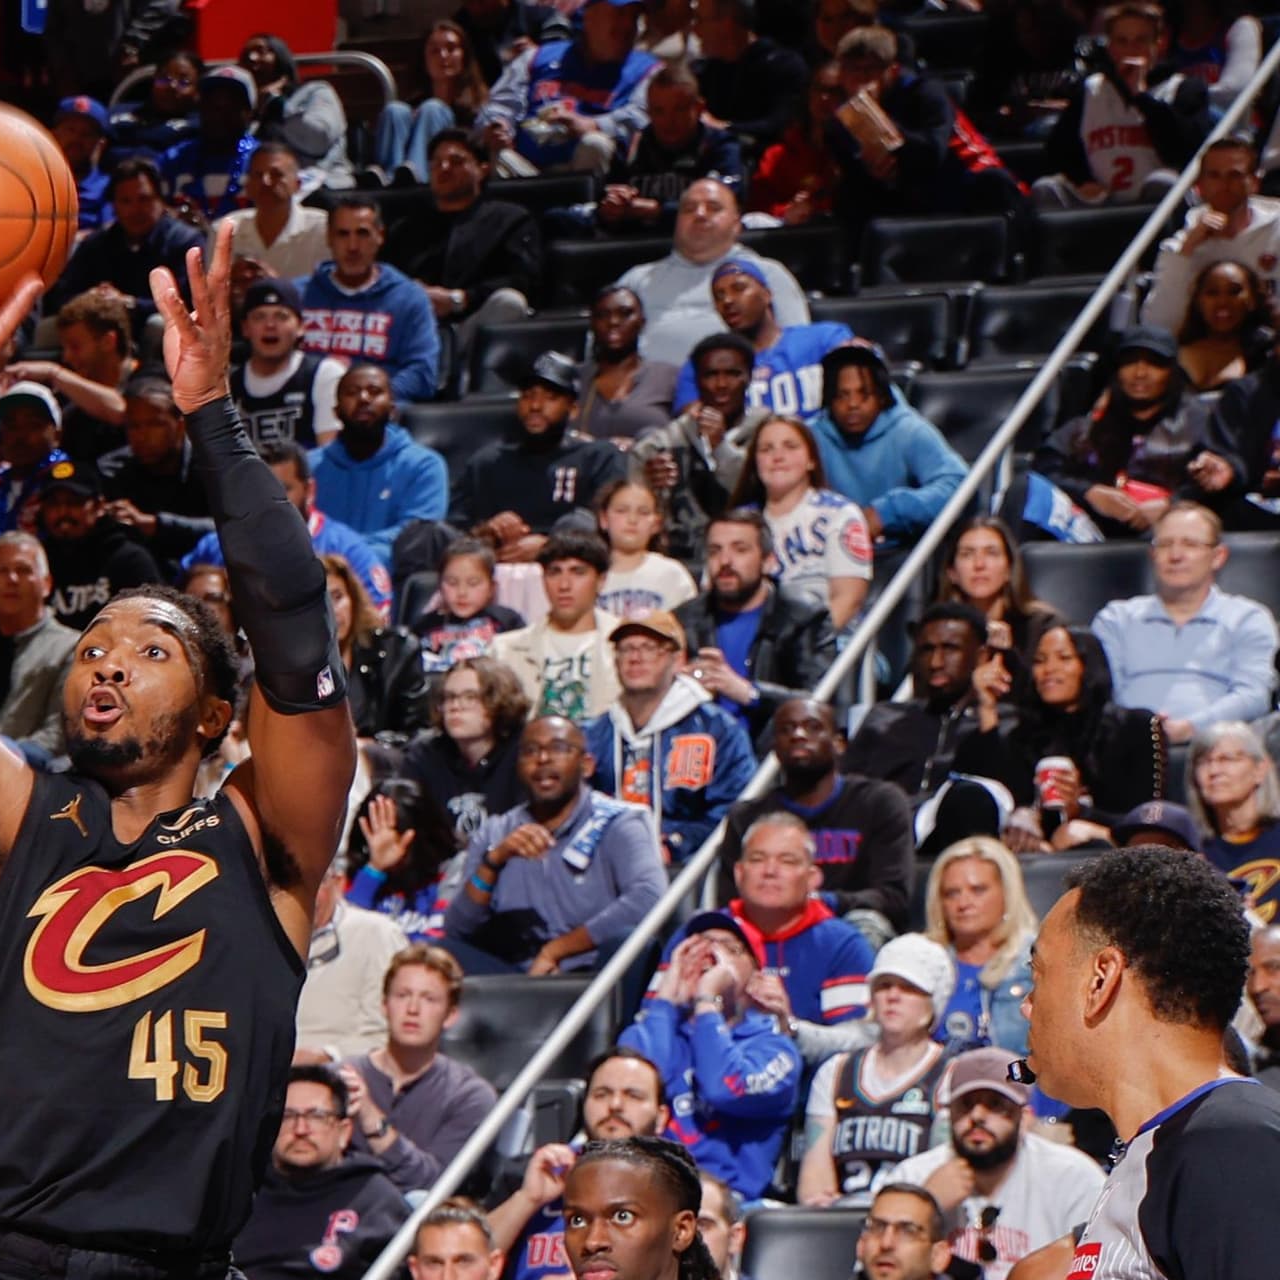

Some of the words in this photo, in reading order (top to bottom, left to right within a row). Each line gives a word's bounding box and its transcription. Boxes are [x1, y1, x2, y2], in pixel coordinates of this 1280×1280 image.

[301, 310, 392, 334] ETROIT
[303, 329, 388, 359] ISTONS
[156, 815, 220, 845] CLIFFS
[128, 1008, 228, 1103] 45
